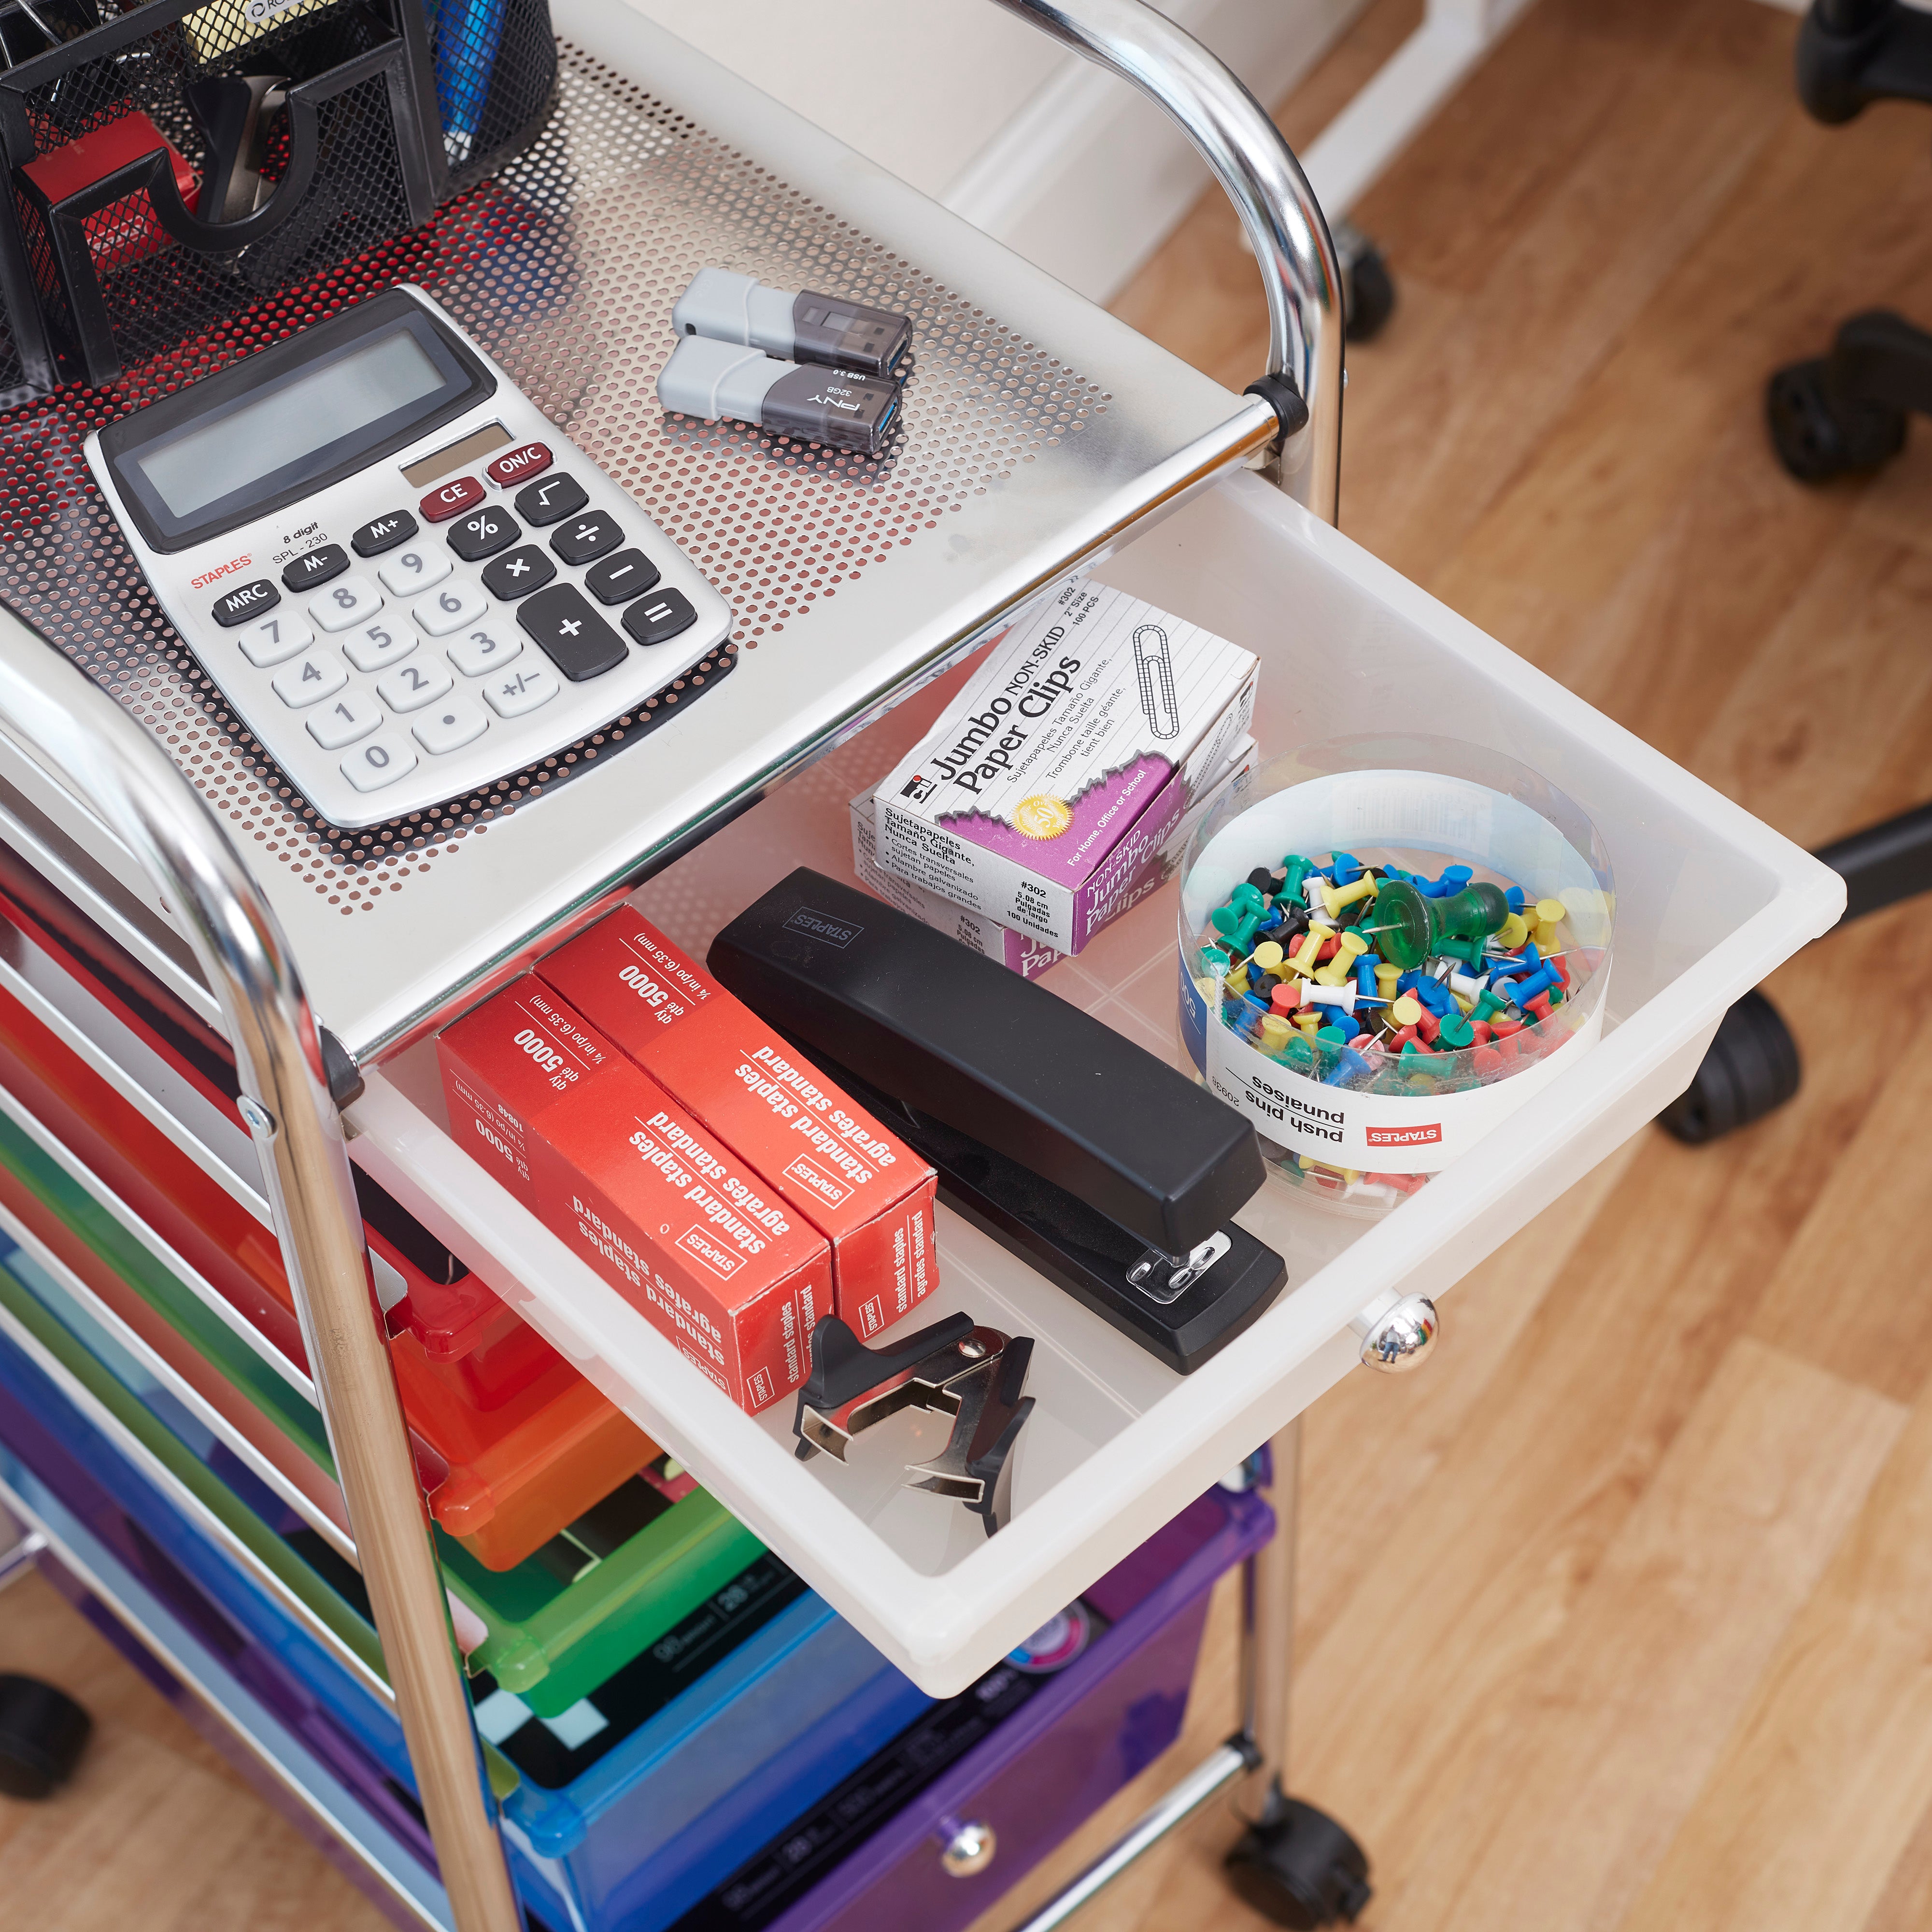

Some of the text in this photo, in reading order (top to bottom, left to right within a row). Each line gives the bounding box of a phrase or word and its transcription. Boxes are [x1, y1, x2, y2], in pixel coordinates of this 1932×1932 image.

[847, 372, 866, 381] USB
[807, 395, 860, 411] PNY
[827, 386, 852, 396] 32GB
[498, 447, 542, 473] ON/C
[440, 483, 468, 503] CE
[284, 521, 318, 543] 8 digit
[370, 518, 398, 539] M+
[467, 515, 498, 540] %
[272, 551, 296, 564] SPL
[305, 533, 327, 549] 230
[303, 555, 327, 572] M-
[401, 554, 423, 573] 9
[225, 583, 268, 612] MRC
[333, 588, 357, 609] 8
[440, 592, 461, 613] 6
[1058, 587, 1076, 605] #302
[1071, 592, 1087, 607] Size
[644, 602, 673, 623] =
[1072, 597, 1099, 625] 100 PCS
[260, 620, 281, 644] 7
[366, 625, 392, 649] 5
[558, 619, 582, 636] +
[470, 632, 496, 654] 3
[302, 661, 322, 683] 4
[400, 668, 429, 691] 2
[335, 703, 355, 723] 1
[930, 626, 1065, 780] Jumbo NON-SKID
[953, 656, 1080, 795] Paper Clips
[1008, 658, 1112, 782] Sujetapapeles Tamaño Gigante,
[1047, 697, 1094, 753] Nunca Suelta
[1046, 688, 1126, 779] Trombone taille géante,
[1080, 719, 1115, 757] tient bien
[365, 746, 389, 768] 0
[885, 808, 961, 850] Sujetapapeles
[1034, 807, 1054, 828] 50
[1067, 769, 1146, 867] For Home, Office or School
[885, 815, 926, 842] Tamaño
[930, 838, 975, 867] Gigante,
[885, 824, 917, 846] Nunca
[922, 843, 955, 865] Suelta
[891, 838, 917, 855] Cortes
[920, 852, 974, 883] transversales
[892, 847, 921, 865] sujetan
[924, 862, 955, 881] papeles
[1086, 808, 1180, 936] Paper Clips
[1087, 830, 1140, 897] NON-SKID
[864, 869, 891, 893] Alambre
[891, 855, 926, 876] Alambre
[929, 873, 979, 900] galvanizado
[892, 863, 909, 875] Para
[912, 872, 945, 893] trabajos
[948, 891, 981, 910] grandes
[1086, 835, 1149, 915] Jumbo
[888, 881, 911, 904] papeles
[1017, 891, 1048, 910] 5.08 cm
[1021, 881, 1047, 898] #302
[1015, 897, 1050, 917] Pulgadas
[1029, 910, 1048, 923] largo
[958, 924, 972, 938] 5.08
[973, 937, 983, 946] cm
[960, 915, 980, 935] #302
[1007, 911, 1020, 921] 100
[1023, 918, 1058, 938] Unidades
[633, 933, 657, 952] mm)
[957, 930, 985, 954] Pulgadas
[652, 951, 680, 972] (6.35
[619, 966, 684, 1016] qté 5000
[676, 970, 701, 992] in/po
[529, 994, 553, 1014] mm)
[548, 1013, 576, 1035] (6.35
[654, 1010, 672, 1024] qty
[514, 1029, 579, 1081] qté 5000
[572, 1033, 596, 1056] in/po
[456, 1080, 472, 1101] mm)
[549, 1075, 566, 1090] qty
[1212, 1076, 1239, 1107] 20938
[474, 1099, 494, 1122] (6.35
[751, 1046, 896, 1166] agrafes standard
[1252, 1076, 1344, 1124] punaises
[497, 1104, 523, 1132] 10848
[735, 1064, 872, 1184] standard staples
[1246, 1091, 1342, 1143] push pins
[496, 1119, 516, 1143] in/po
[475, 1119, 528, 1171] qté 5000
[518, 1166, 530, 1181] qty
[646, 1111, 790, 1236] agrafes standard
[629, 1131, 766, 1254] standard staples
[578, 1221, 641, 1287] staples
[686, 1234, 735, 1271] STAPLES
[911, 1209, 927, 1298] agrafes standard
[573, 1195, 721, 1344] agrafes standard
[893, 1228, 907, 1313] standard staples
[800, 1285, 815, 1331] standard
[865, 1302, 878, 1332] STAPLES
[646, 1284, 724, 1365] standard
[781, 1301, 799, 1383] standard staples
[753, 1374, 768, 1402] STAPLES
